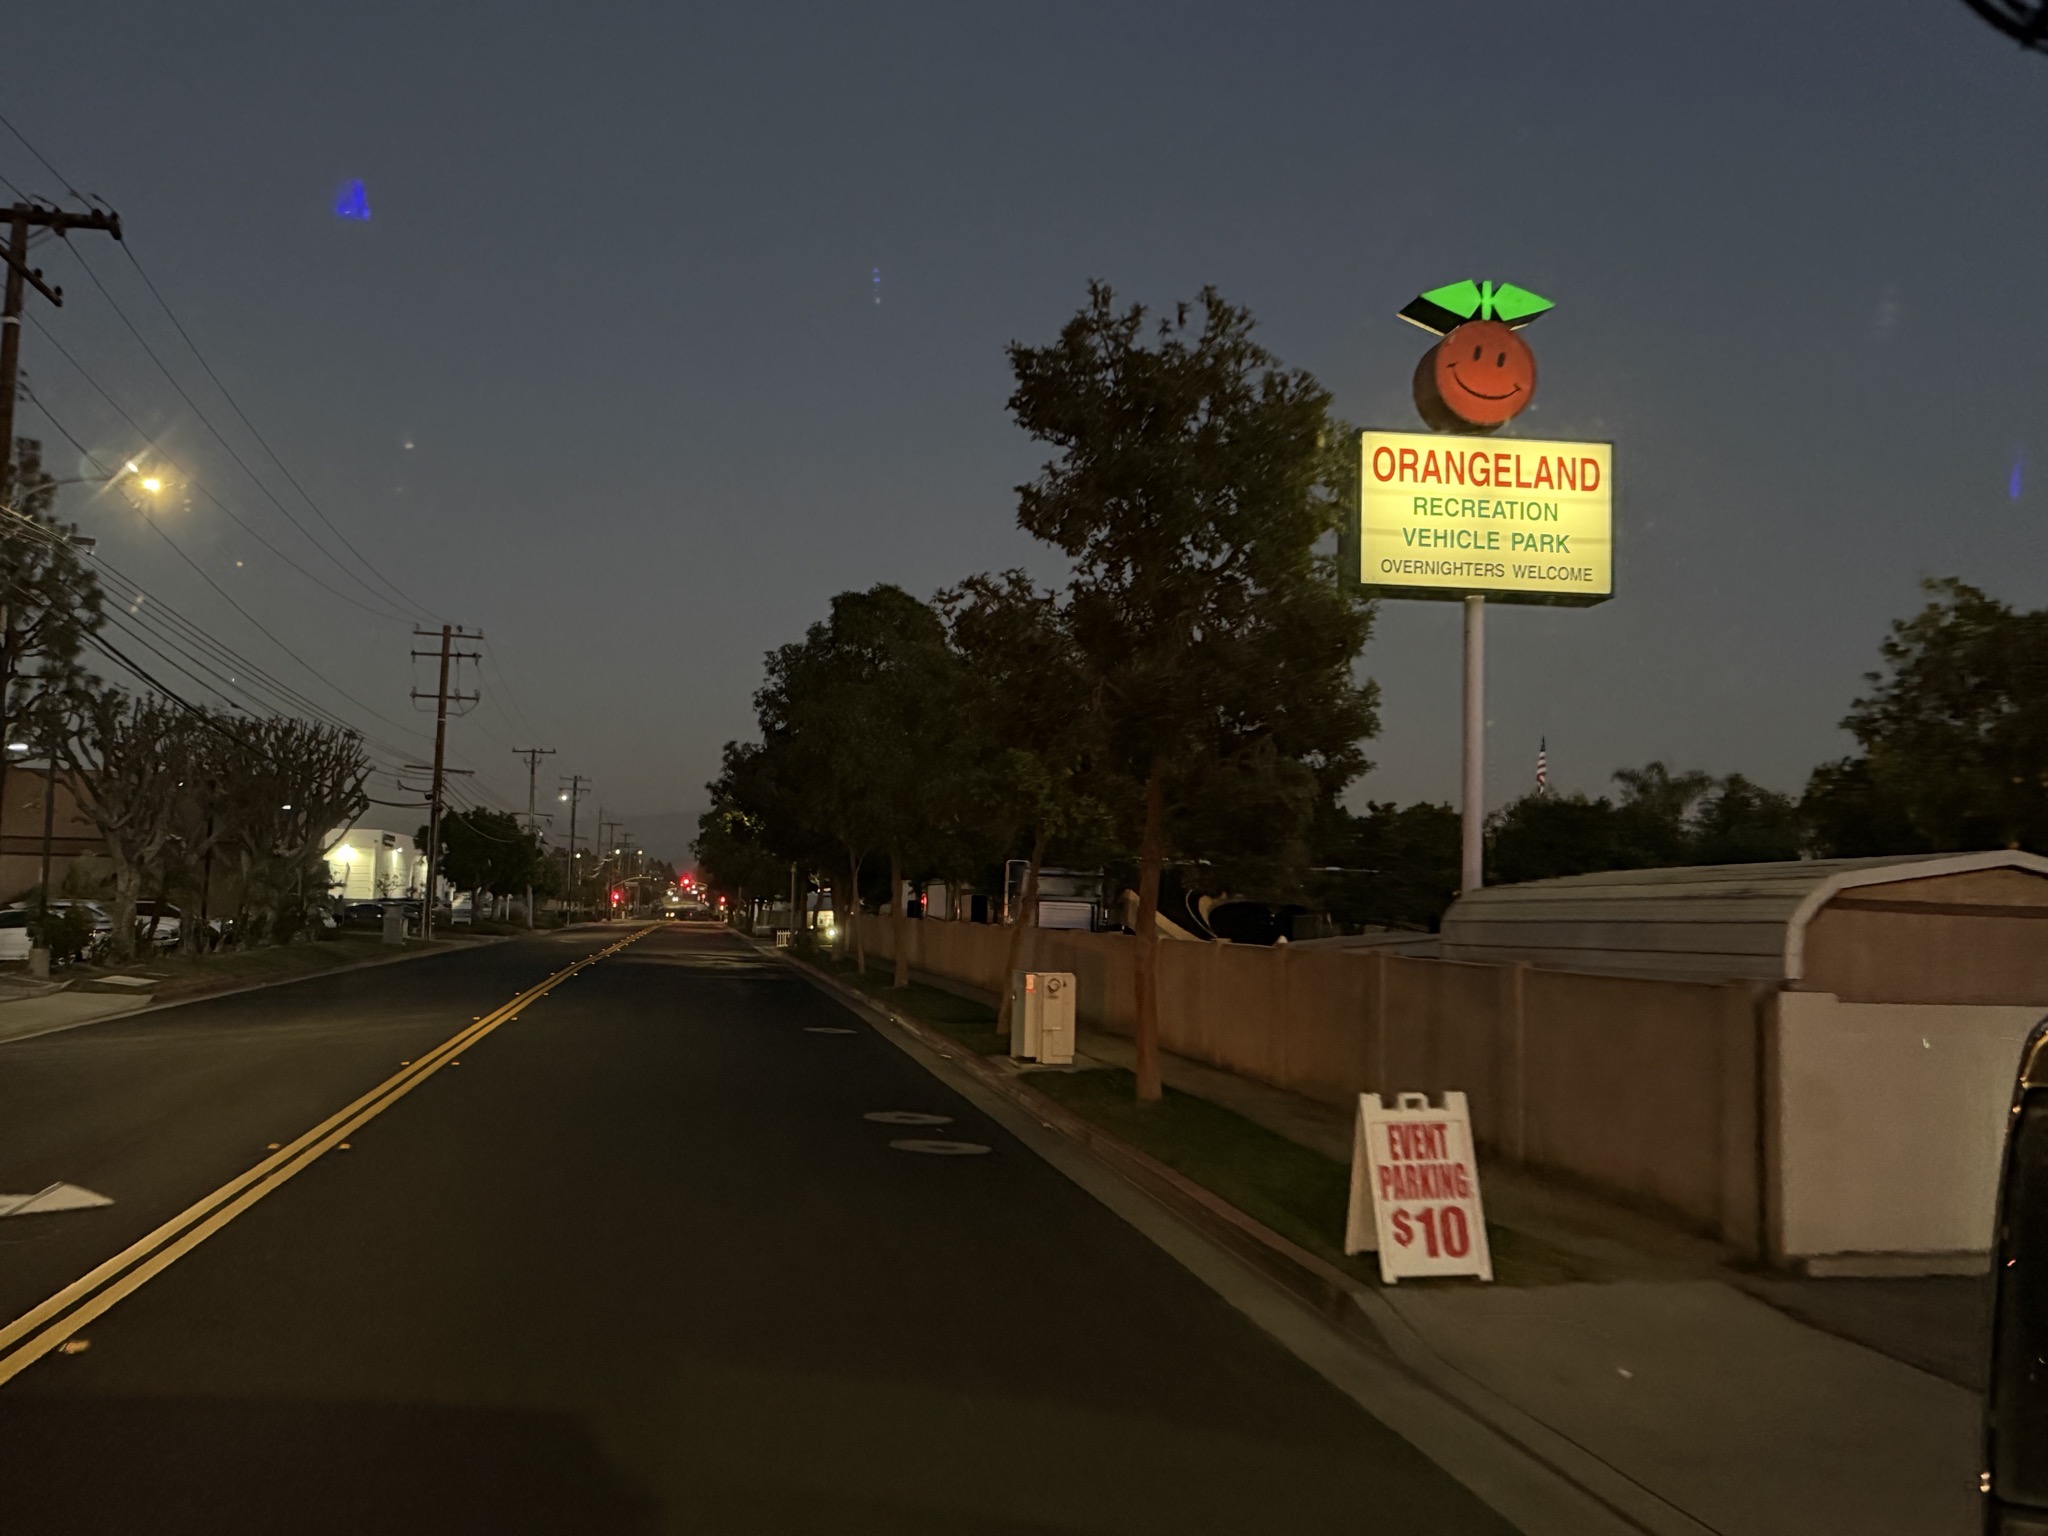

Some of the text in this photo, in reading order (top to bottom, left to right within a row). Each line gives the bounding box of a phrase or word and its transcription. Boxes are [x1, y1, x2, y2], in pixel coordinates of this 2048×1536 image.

[1373, 446, 1600, 491] ORANGELAND
[1413, 497, 1558, 521] RECREATION
[1402, 528, 1570, 553] VEHICLE PARK
[1381, 559, 1593, 581] OVERNIGHTERS WELCOME
[1387, 1123, 1447, 1160] EVENT
[1378, 1163, 1471, 1200] PARKING
[1391, 1206, 1470, 1258] $10
